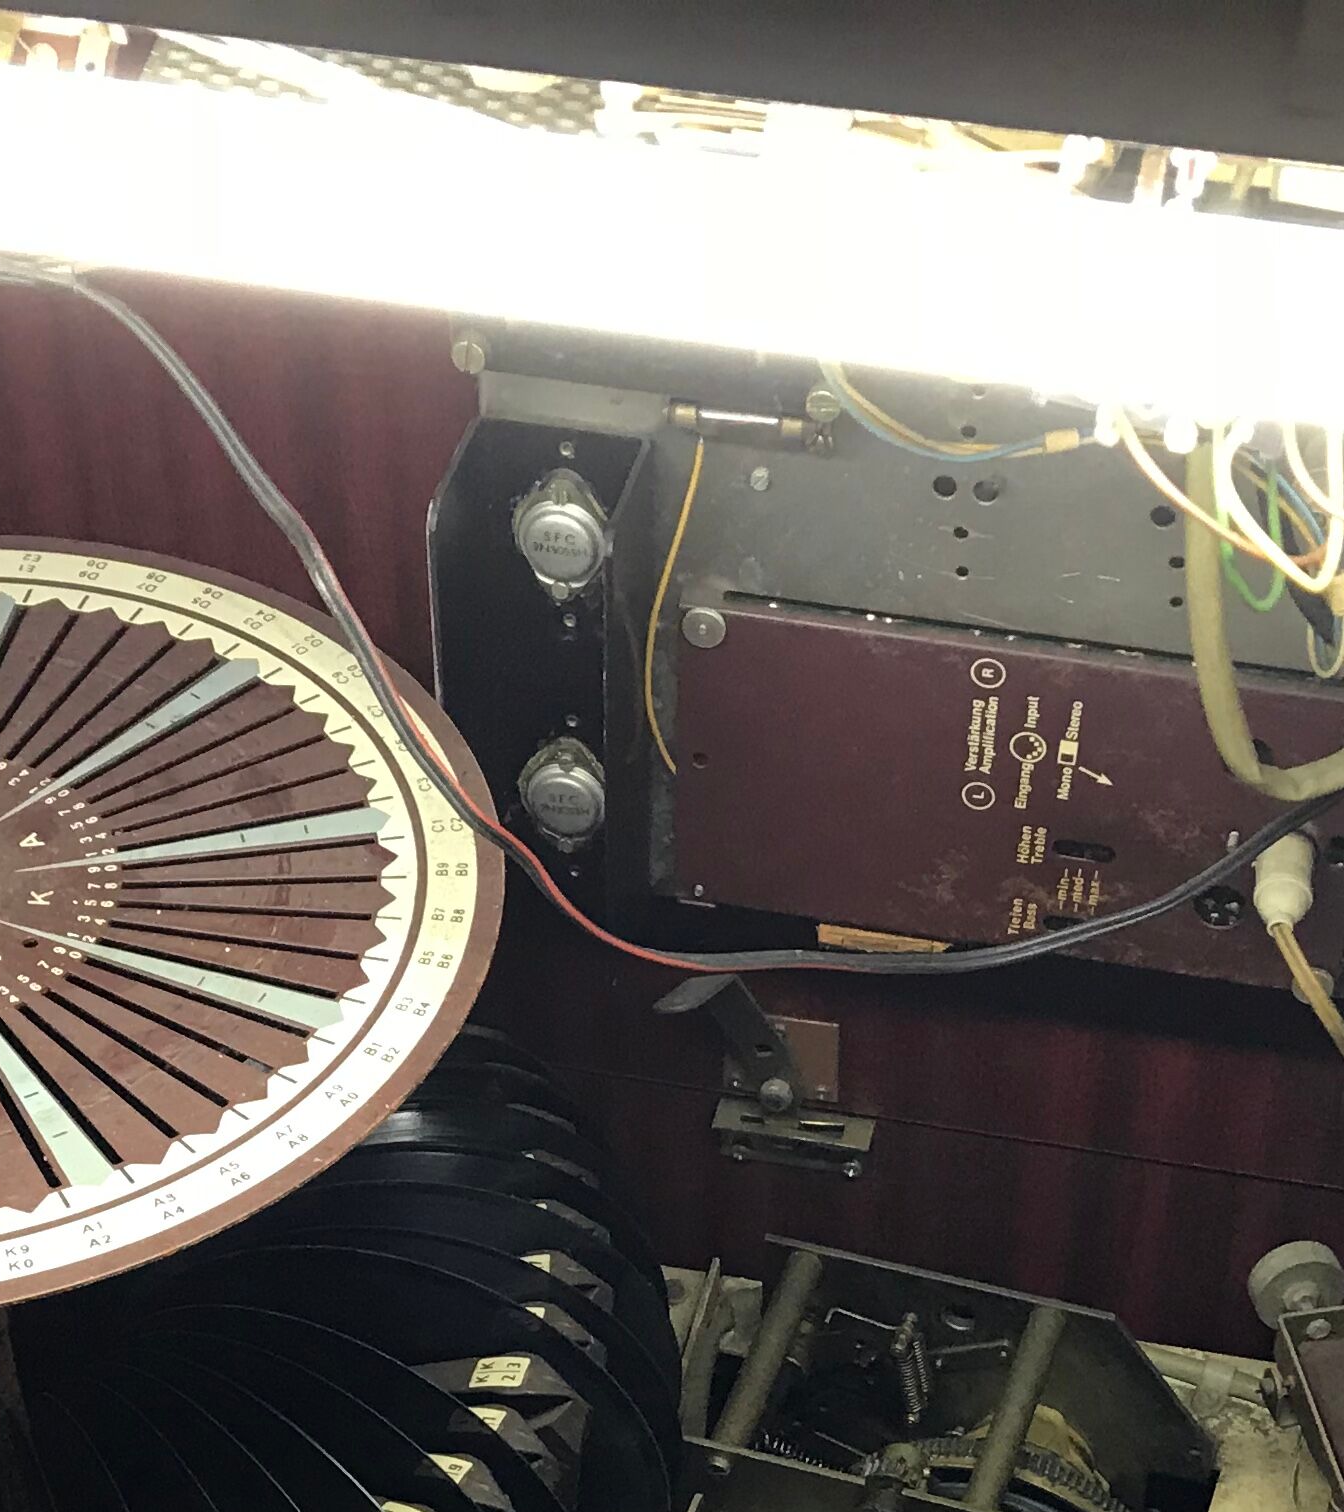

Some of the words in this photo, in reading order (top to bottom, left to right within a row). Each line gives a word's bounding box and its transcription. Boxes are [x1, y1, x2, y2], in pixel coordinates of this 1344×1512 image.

[981, 667, 995, 679] R
[1024, 696, 1040, 728] Input
[1066, 701, 1084, 740] Stereo
[964, 700, 985, 772] Verstärkung
[979, 696, 999, 775] Amplification
[972, 791, 985, 799] L
[1014, 762, 1034, 809] Eingang
[1056, 767, 1073, 801] Mono
[19, 832, 45, 847] A
[1016, 825, 1032, 864] Höhen
[1030, 826, 1047, 864] Treble
[27, 890, 54, 906] K
